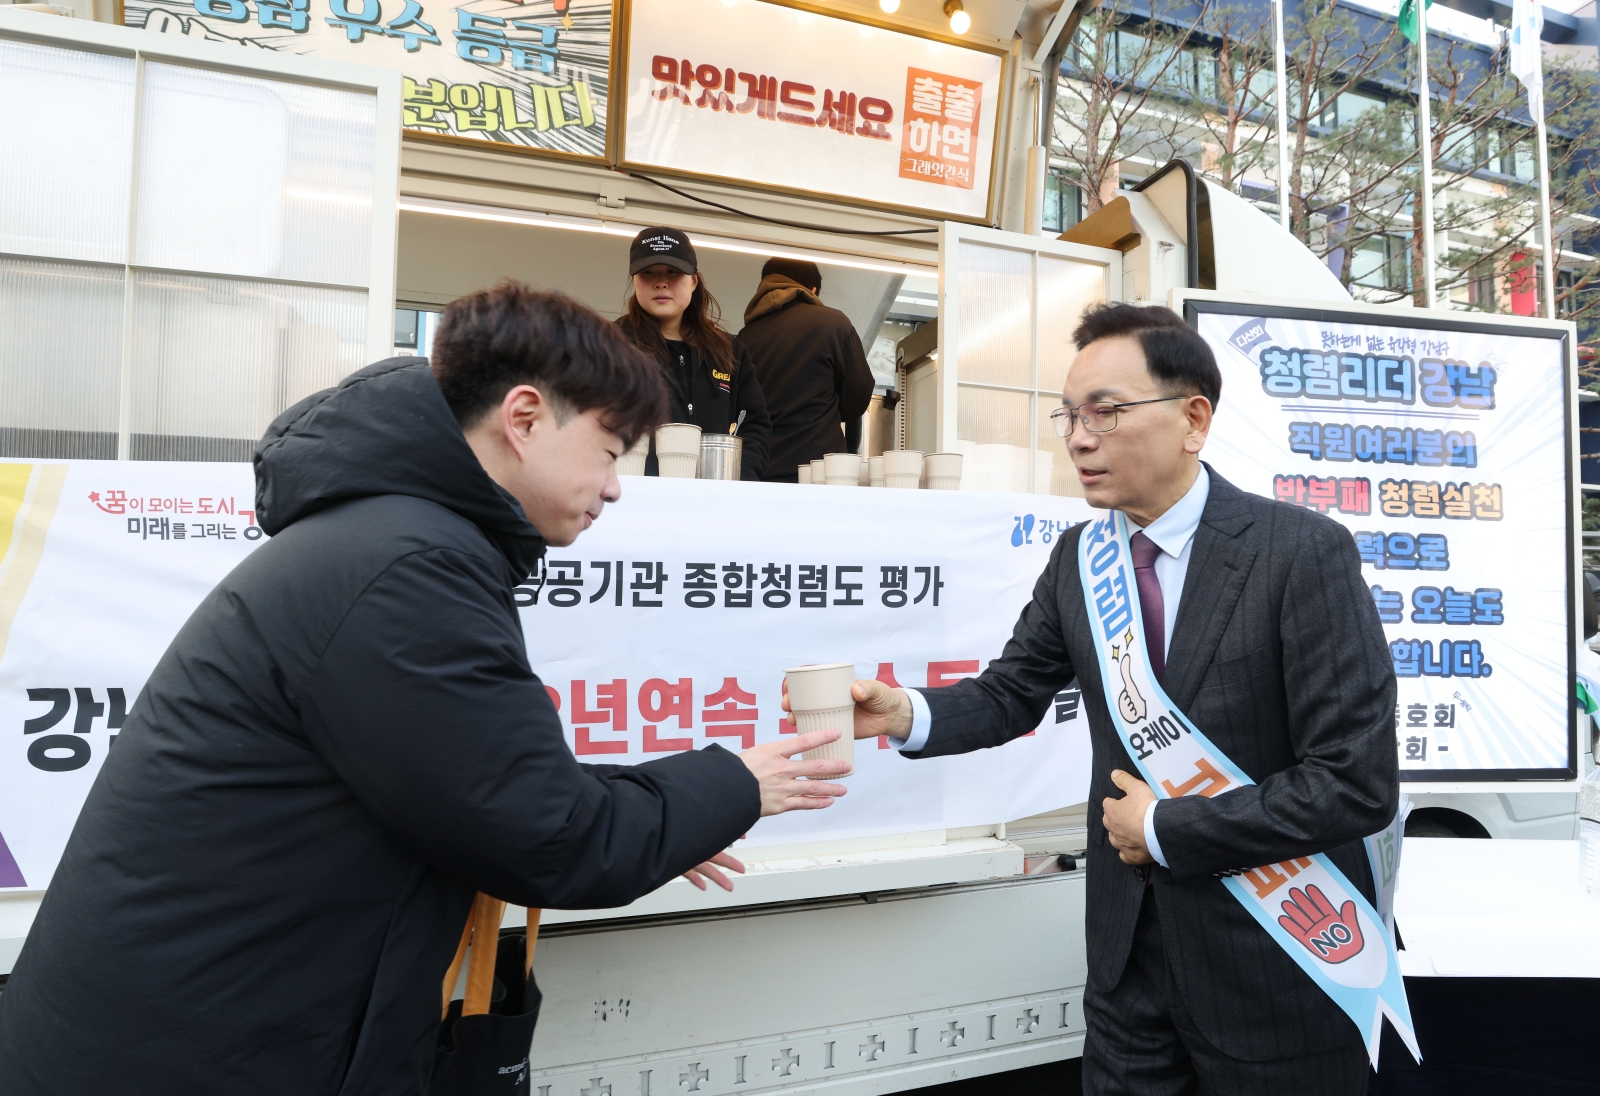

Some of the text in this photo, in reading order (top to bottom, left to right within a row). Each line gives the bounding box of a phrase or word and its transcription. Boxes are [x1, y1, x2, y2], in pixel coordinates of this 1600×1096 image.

[452, 7, 561, 74] 등급
[651, 54, 894, 142] 맛있게드세요
[912, 77, 975, 123] 출출
[909, 117, 972, 163] 하면
[903, 157, 970, 183] 그레잇간식
[1321, 330, 1450, 356] 못하는게 없는 육각형 강남구
[712, 369, 730, 381] GRE
[1261, 348, 1497, 409] 청렴리더 강남
[1290, 422, 1477, 468] 직원여러분의
[105, 490, 235, 515] 꿈이 모이는 도시
[1380, 478, 1502, 521] 청렴실천
[127, 517, 187, 540] 미래를
[191, 523, 237, 540] 그리는
[683, 561, 864, 608] 종합청렴도
[880, 565, 944, 607] 평가
[1086, 509, 1134, 643] 청렴
[1411, 586, 1504, 625] 오늘도
[1129, 709, 1192, 761] 오케이
[1312, 923, 1351, 956] NO
